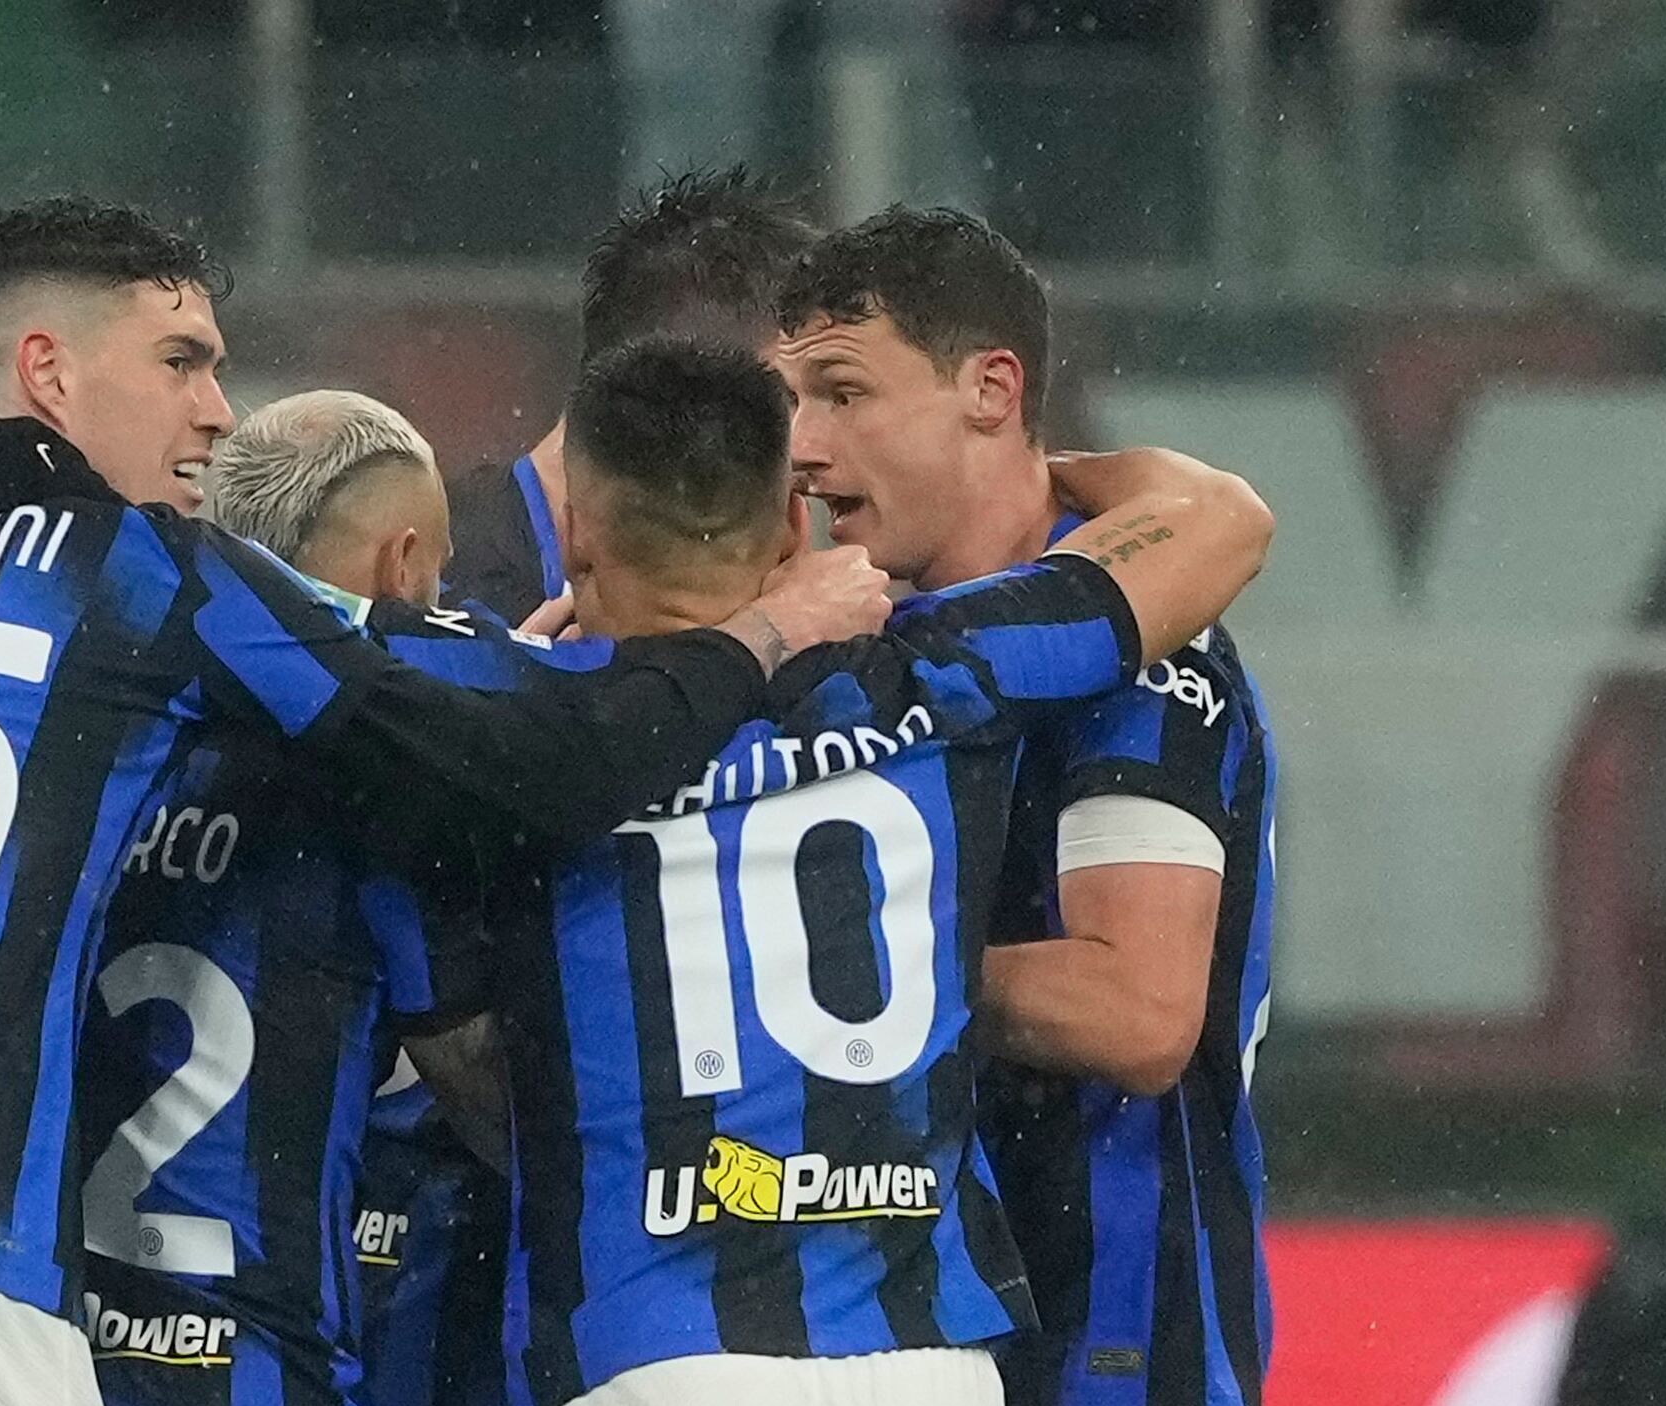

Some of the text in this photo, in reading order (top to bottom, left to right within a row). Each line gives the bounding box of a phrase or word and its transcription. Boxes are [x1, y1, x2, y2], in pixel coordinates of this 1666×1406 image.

[611, 768, 936, 1098] 10
[82, 943, 255, 1278] 2
[780, 1152, 937, 1222] Power
